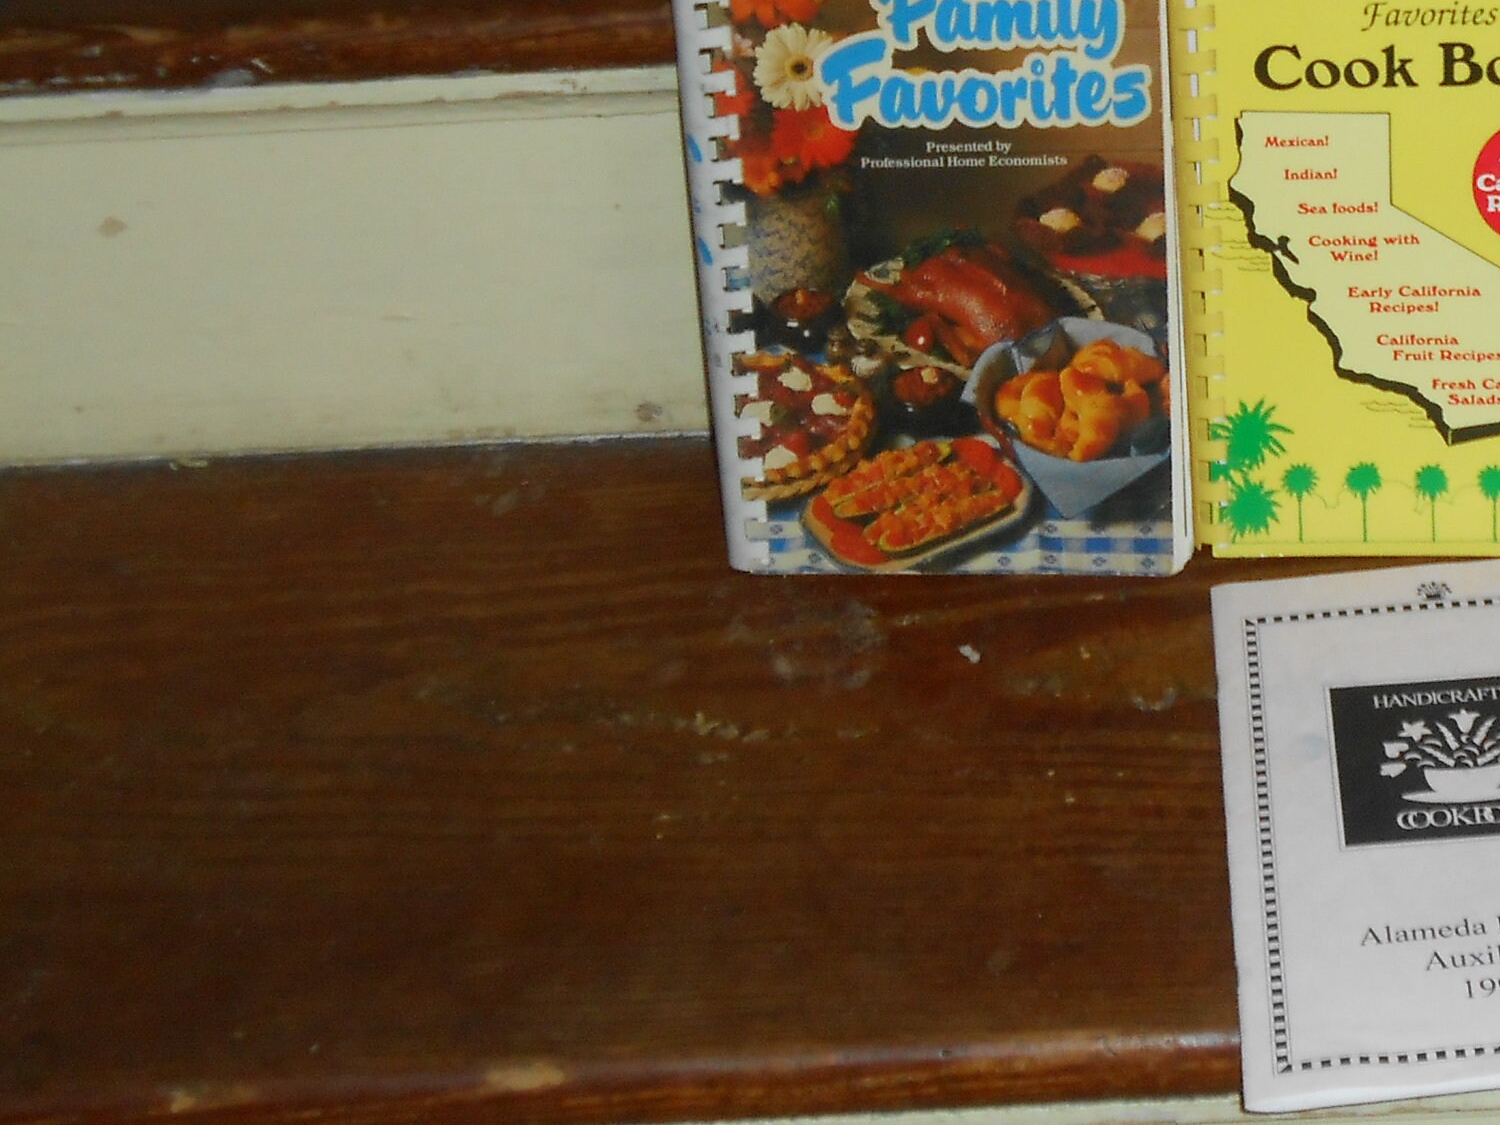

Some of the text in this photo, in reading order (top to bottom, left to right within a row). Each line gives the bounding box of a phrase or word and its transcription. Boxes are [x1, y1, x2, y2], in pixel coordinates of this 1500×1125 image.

[1361, 2, 1499, 32] Favorites
[1253, 43, 1419, 91] Cook
[820, 38, 1148, 125] Favorites
[926, 140, 1012, 154] Presented by
[1265, 135, 1329, 149] Mexican!
[860, 154, 1068, 169] Professional Home Economists
[1283, 167, 1338, 181] Indian!
[1297, 201, 1379, 215] Sea foods!
[1308, 233, 1420, 251] Cooking with
[1330, 249, 1379, 263] Wine!
[1347, 285, 1482, 302] Early California
[1369, 301, 1440, 316] Recipes!
[1376, 334, 1460, 347] California
[1393, 349, 1435, 362] Fruit
[1431, 378, 1478, 391] Fresh
[1360, 918, 1488, 947] Alameda
